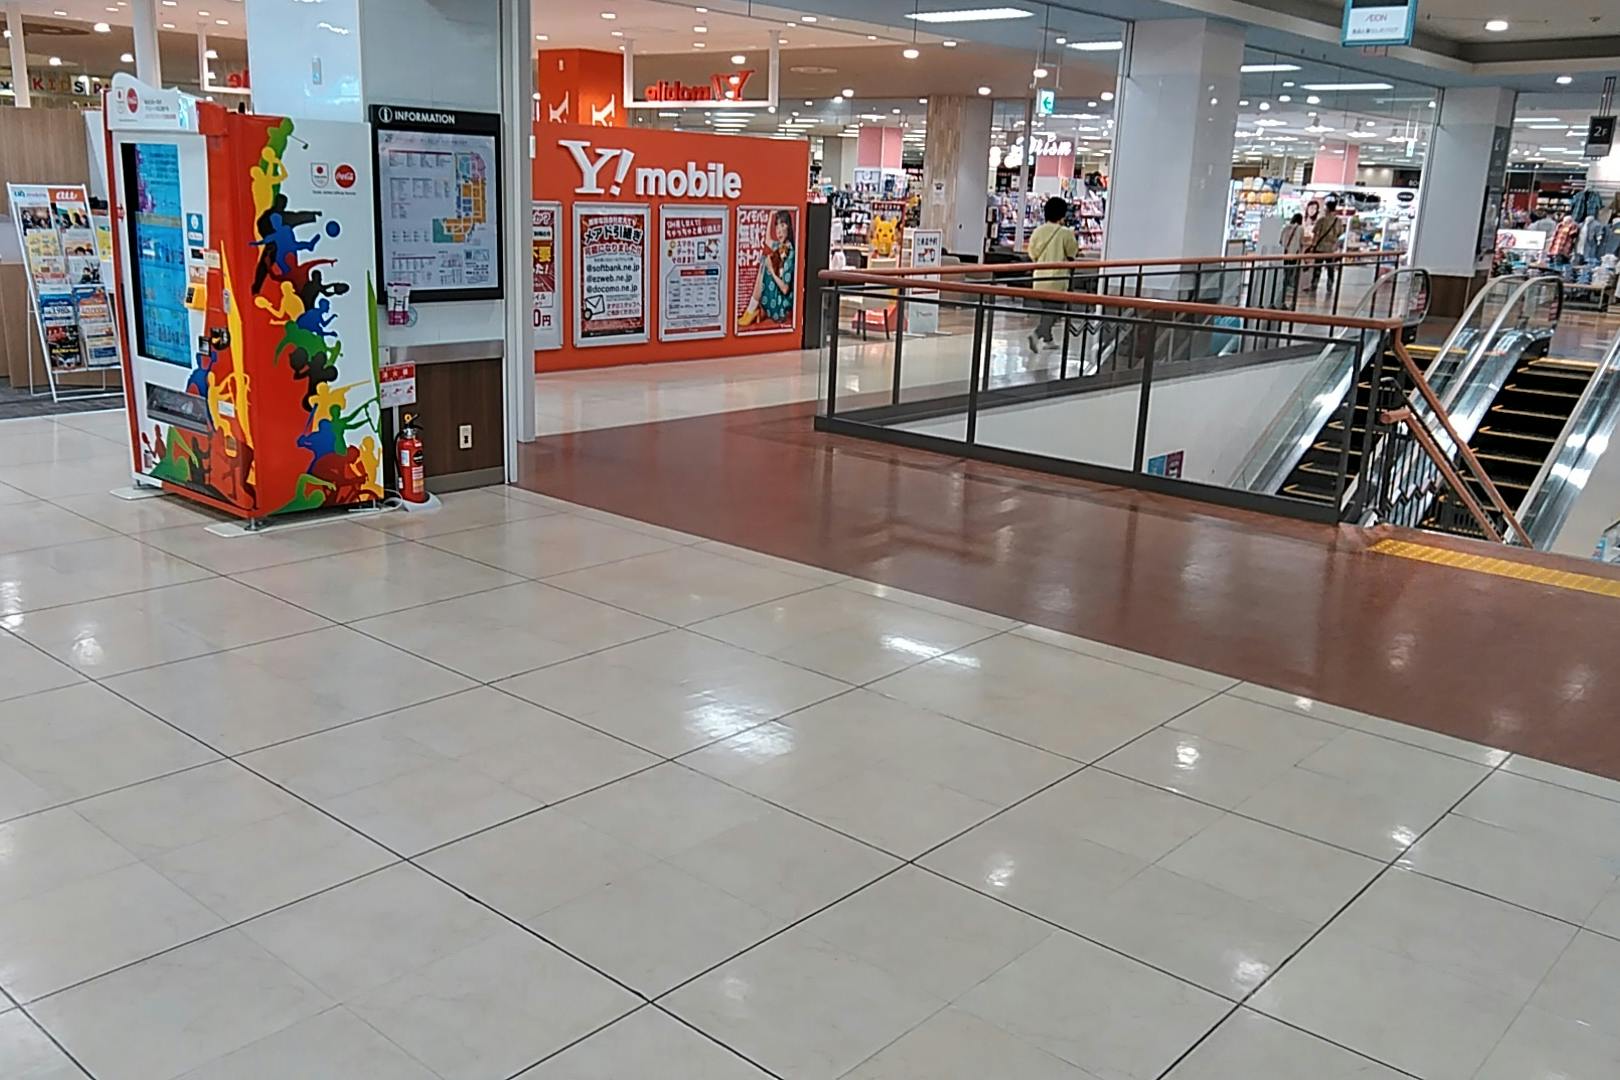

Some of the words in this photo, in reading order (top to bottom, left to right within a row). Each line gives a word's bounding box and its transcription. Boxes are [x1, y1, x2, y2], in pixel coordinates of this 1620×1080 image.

[394, 110, 456, 124] INFORMATION
[1593, 126, 1609, 137] 2F
[55, 191, 78, 200] au
[586, 263, 640, 272] @softbank.ne.jp
[586, 274, 633, 283] @ezweb.ne.jp
[586, 284, 638, 293] @docomo.ne.jp
